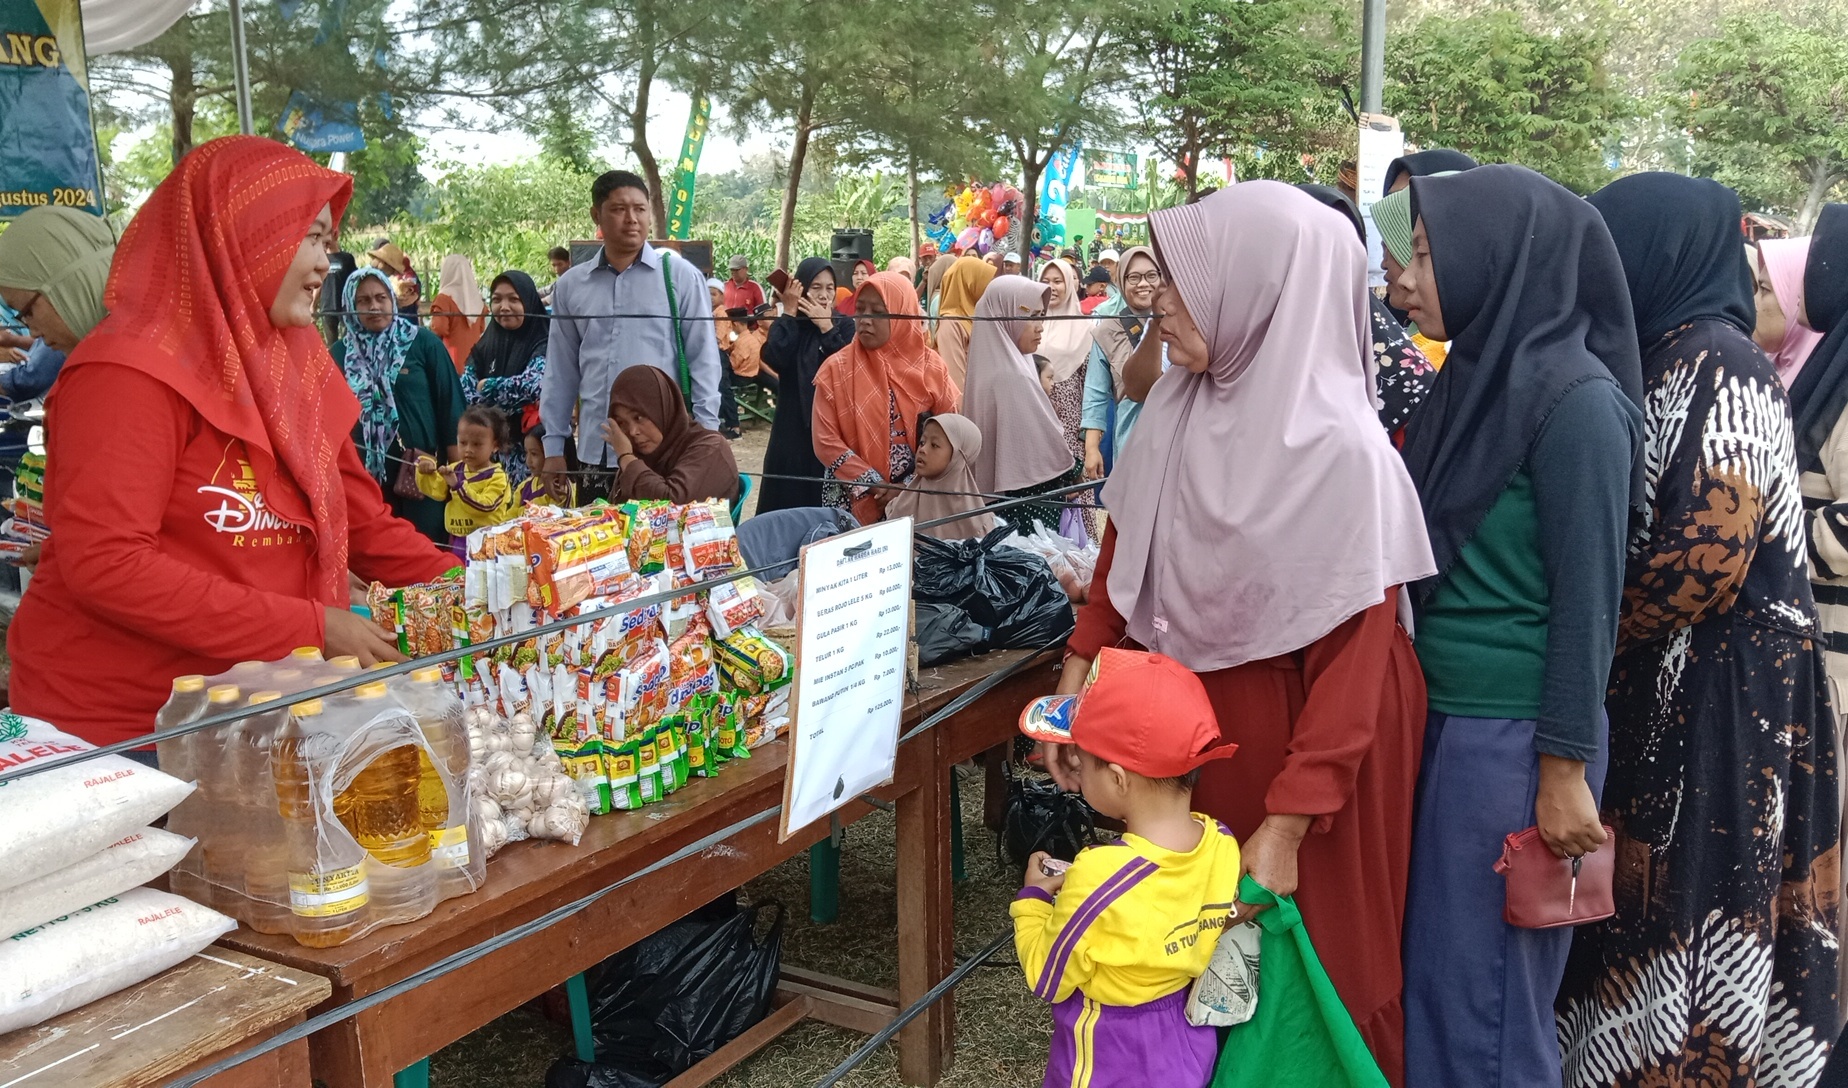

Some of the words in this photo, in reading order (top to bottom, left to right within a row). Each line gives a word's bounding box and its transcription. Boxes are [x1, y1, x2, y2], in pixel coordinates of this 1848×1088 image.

[0, 189, 48, 208] ustus
[53, 188, 97, 207] 2024
[816, 582, 837, 594] MINYAK
[838, 578, 849, 587] KITA
[854, 571, 868, 581] LITER
[817, 606, 834, 617] BERAS
[848, 596, 860, 606] LELE
[865, 592, 873, 600] KG
[816, 630, 830, 640] GULA
[831, 624, 845, 635] PASIR
[850, 619, 858, 627] KG
[815, 651, 831, 662] TELUR
[836, 646, 844, 654] KG
[813, 676, 824, 685] MIE
[825, 668, 843, 681] INSTAN
[812, 693, 834, 708] BAWANG
[835, 686, 849, 697] PUTIH
[84, 769, 135, 788] RAJALELE
[138, 907, 182, 925] RAJALELE
[1164, 941, 1179, 956] KB
